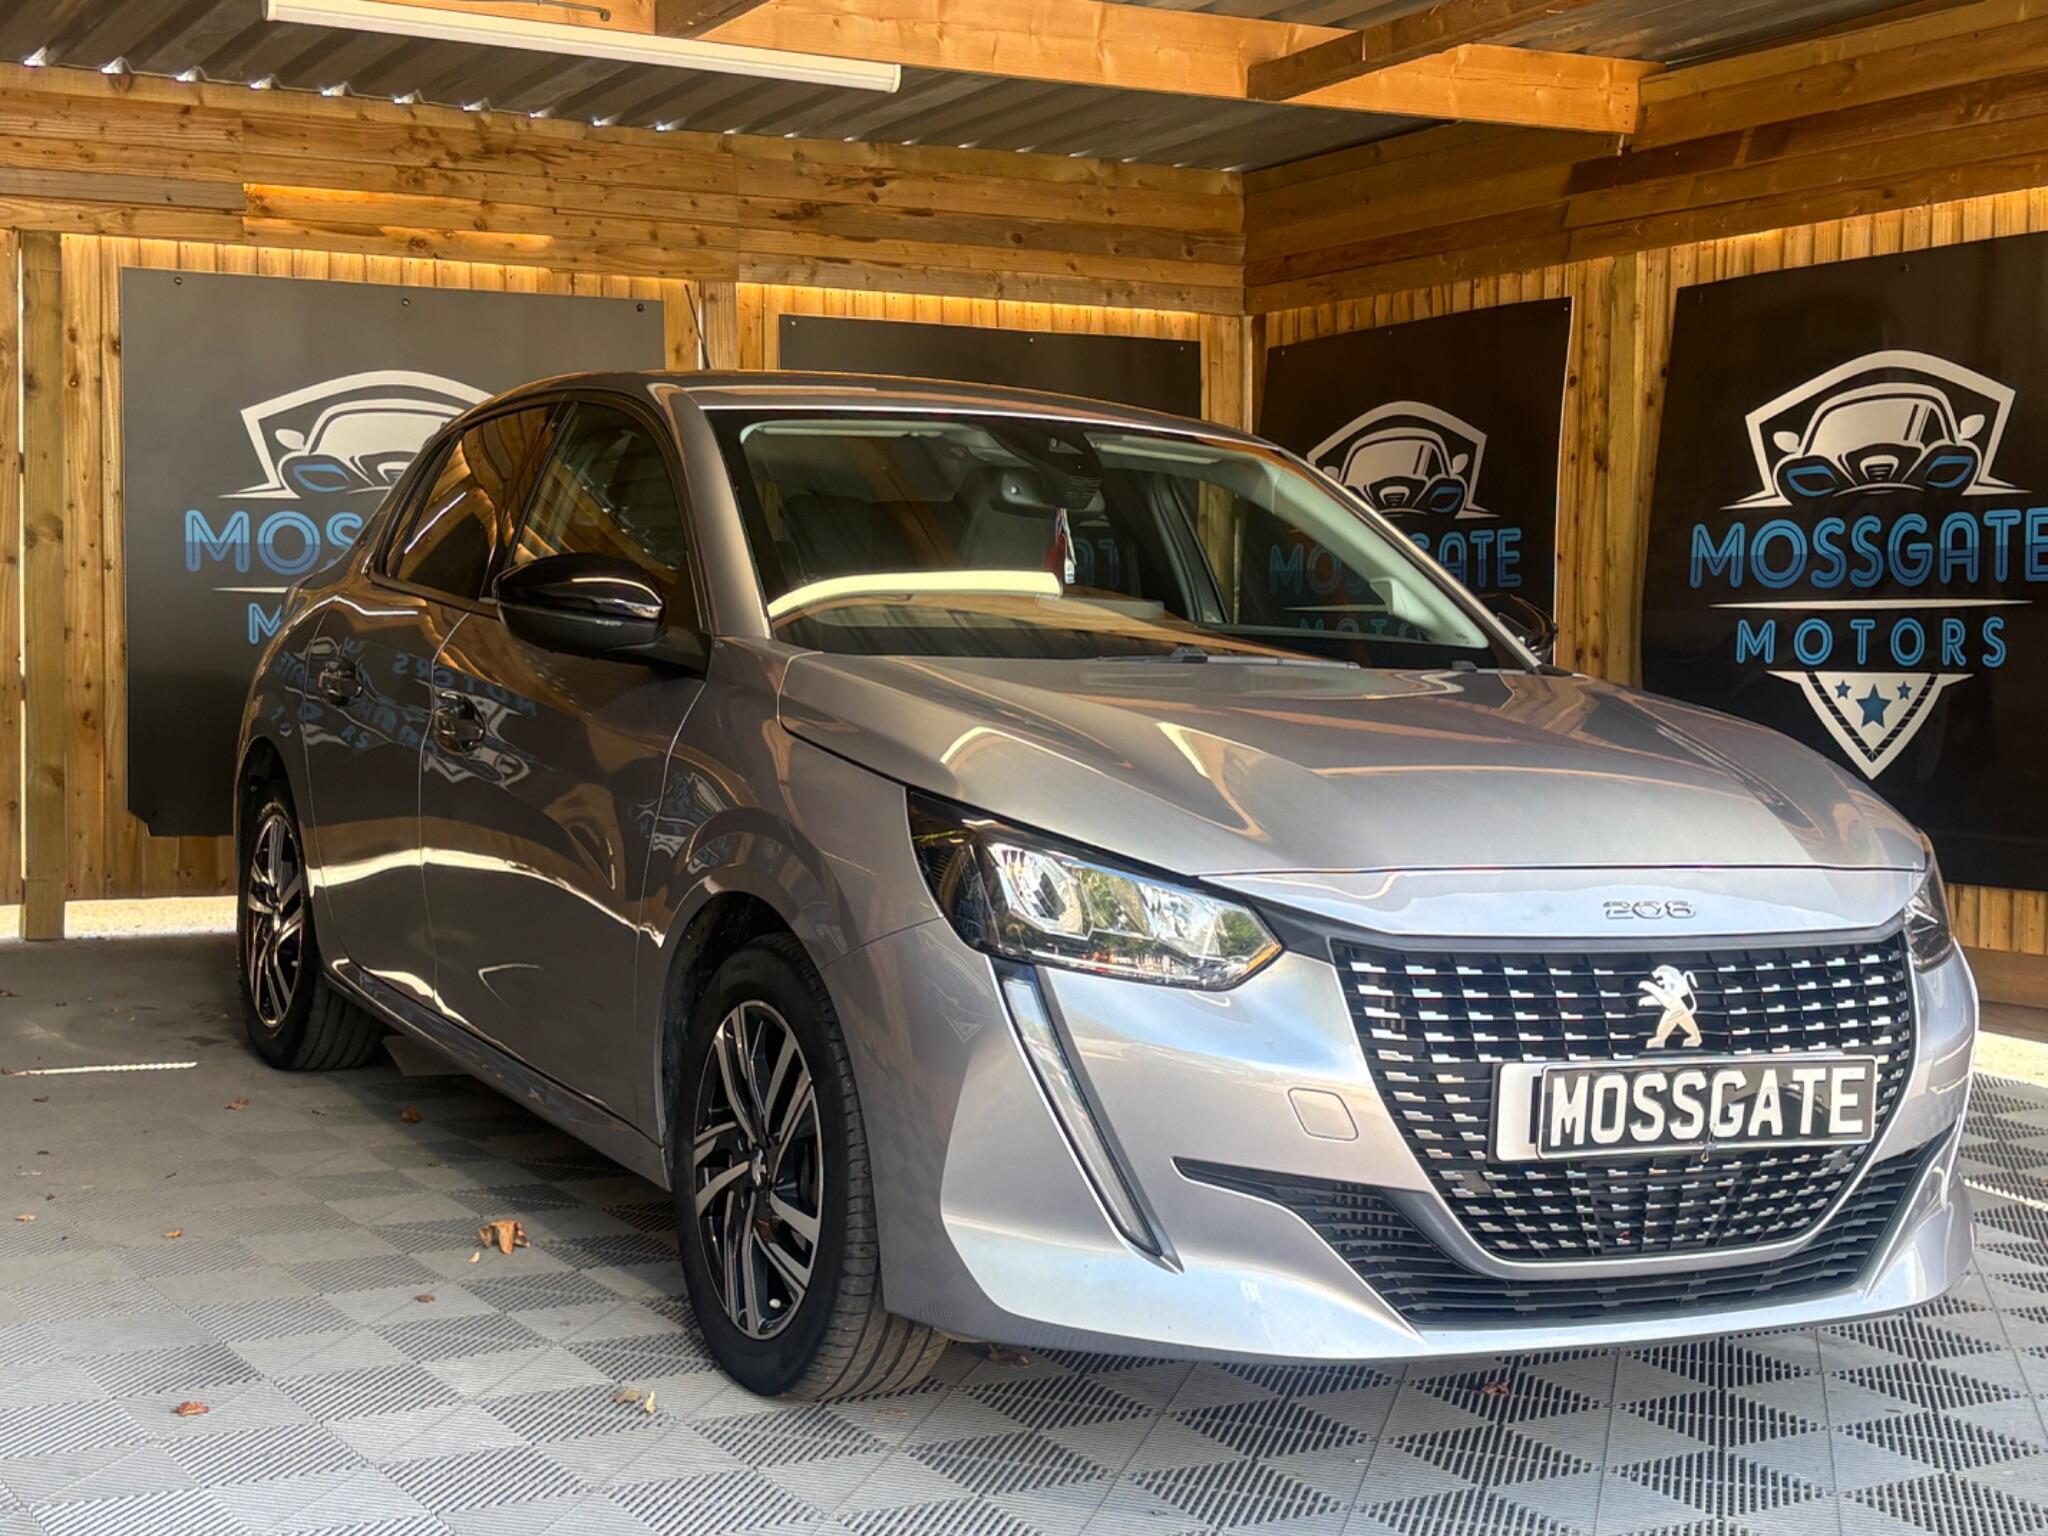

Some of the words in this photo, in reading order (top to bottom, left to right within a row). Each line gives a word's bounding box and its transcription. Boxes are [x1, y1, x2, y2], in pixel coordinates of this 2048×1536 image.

[1689, 507, 2048, 589] MOSSGATE
[1736, 615, 2007, 668] MOTORS
[1602, 900, 1696, 920] 208
[1549, 1066, 1866, 1147] MOSSGATE
